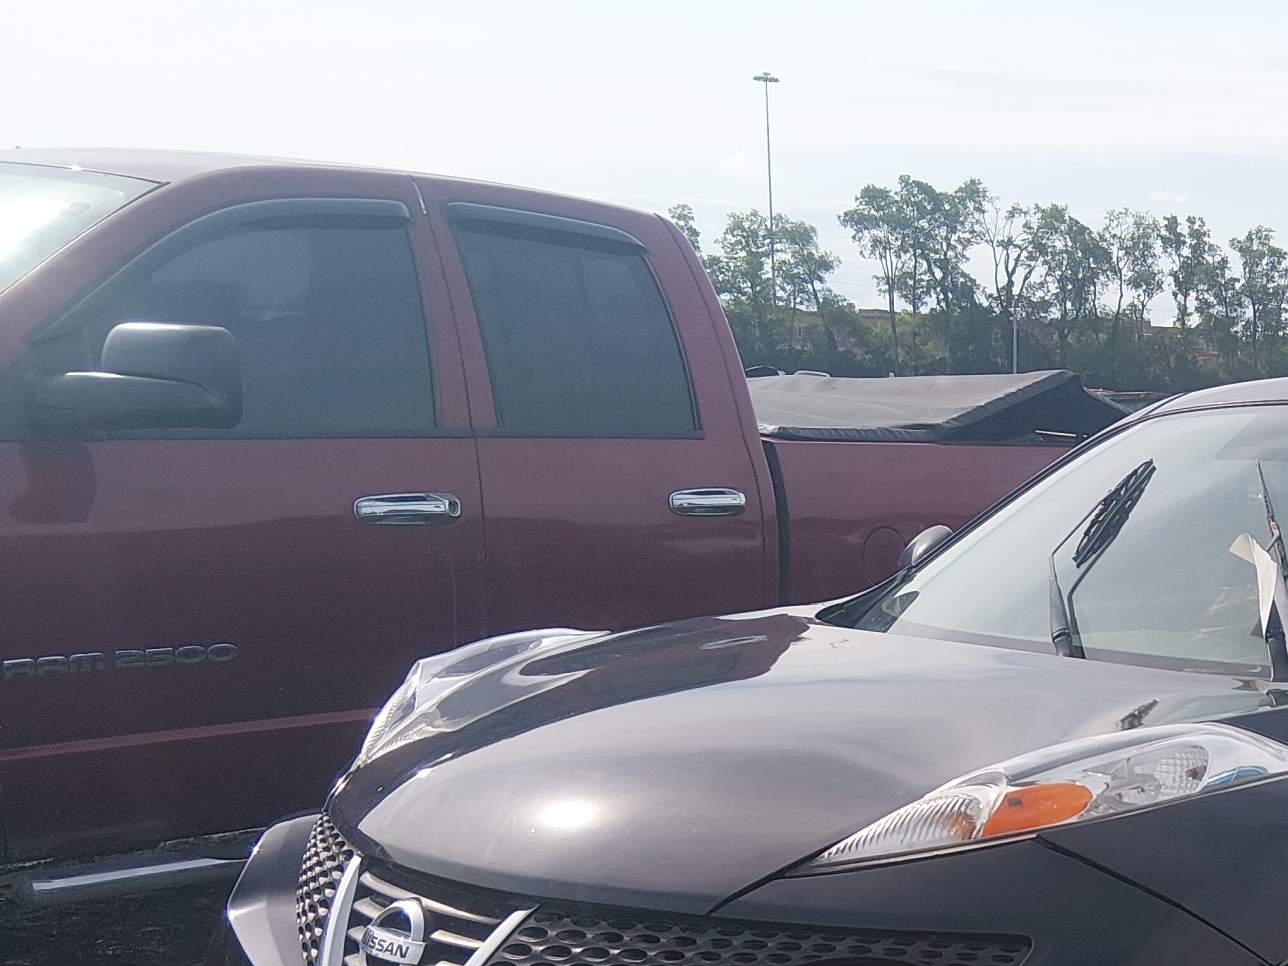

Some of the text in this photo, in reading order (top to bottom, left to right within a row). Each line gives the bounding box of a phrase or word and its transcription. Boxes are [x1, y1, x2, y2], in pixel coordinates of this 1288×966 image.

[3, 643, 239, 679] RAM 2500
[364, 928, 410, 959] NISSAN
